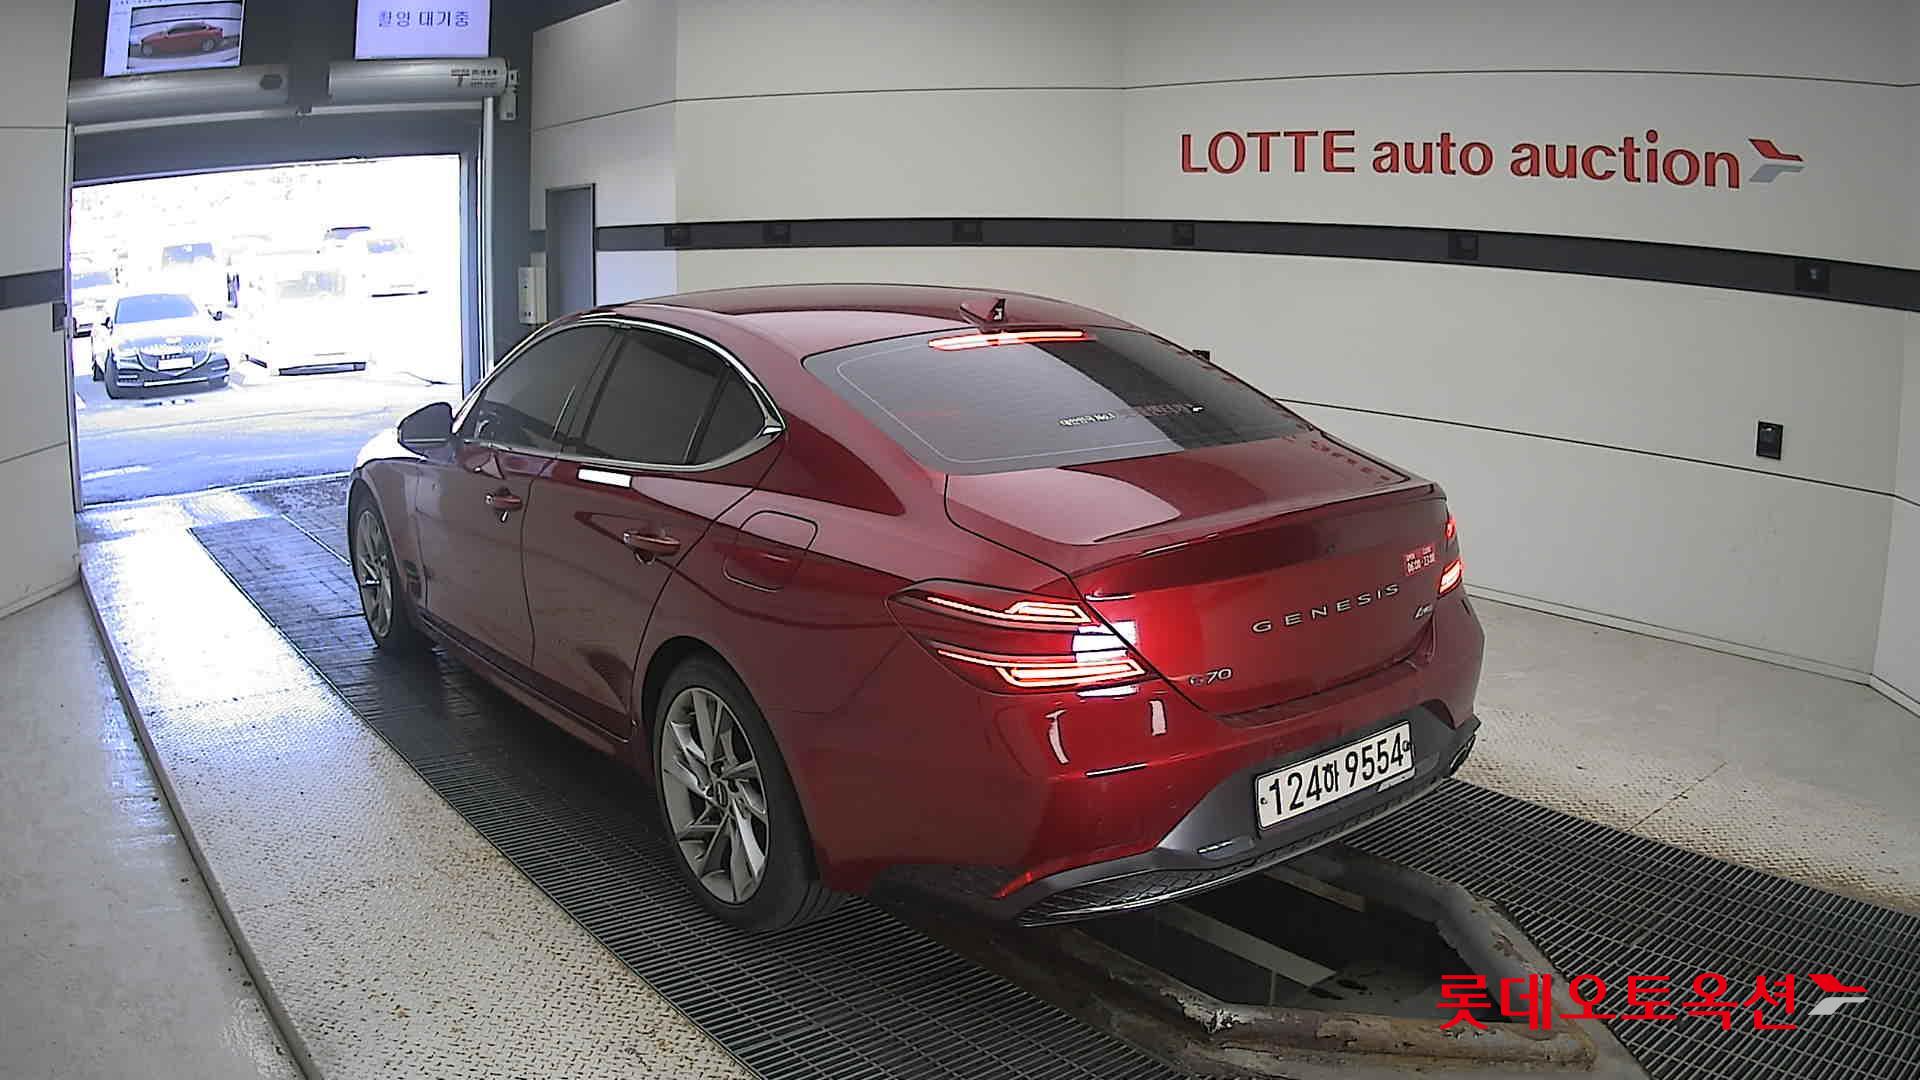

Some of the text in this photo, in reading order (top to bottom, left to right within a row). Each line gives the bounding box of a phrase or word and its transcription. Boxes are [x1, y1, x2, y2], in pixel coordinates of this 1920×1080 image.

[418, 10, 470, 28] 대기중
[1181, 128, 1741, 189] LOTTE auto auction
[1251, 583, 1400, 634] GENESIS
[1269, 732, 1404, 816] 124하 9554
